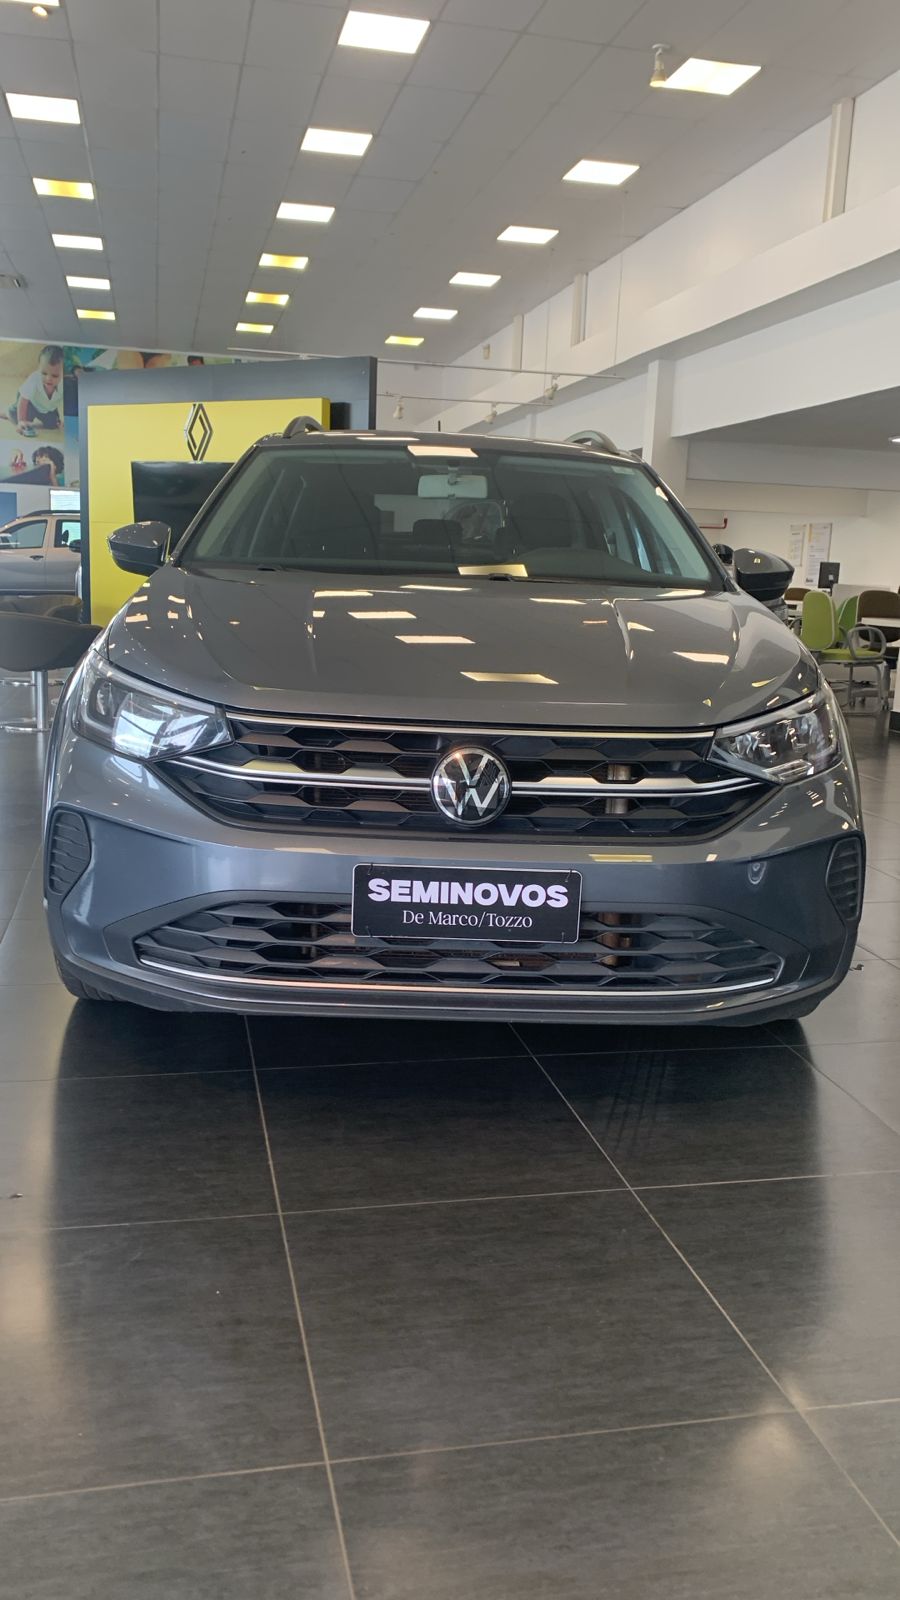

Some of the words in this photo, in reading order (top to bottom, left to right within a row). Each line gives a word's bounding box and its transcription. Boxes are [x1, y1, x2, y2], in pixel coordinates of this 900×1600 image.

[437, 751, 506, 819] VW
[367, 878, 569, 908] SEMINOVOS
[402, 910, 424, 925] De
[429, 911, 533, 928] Marco/Tozzo
